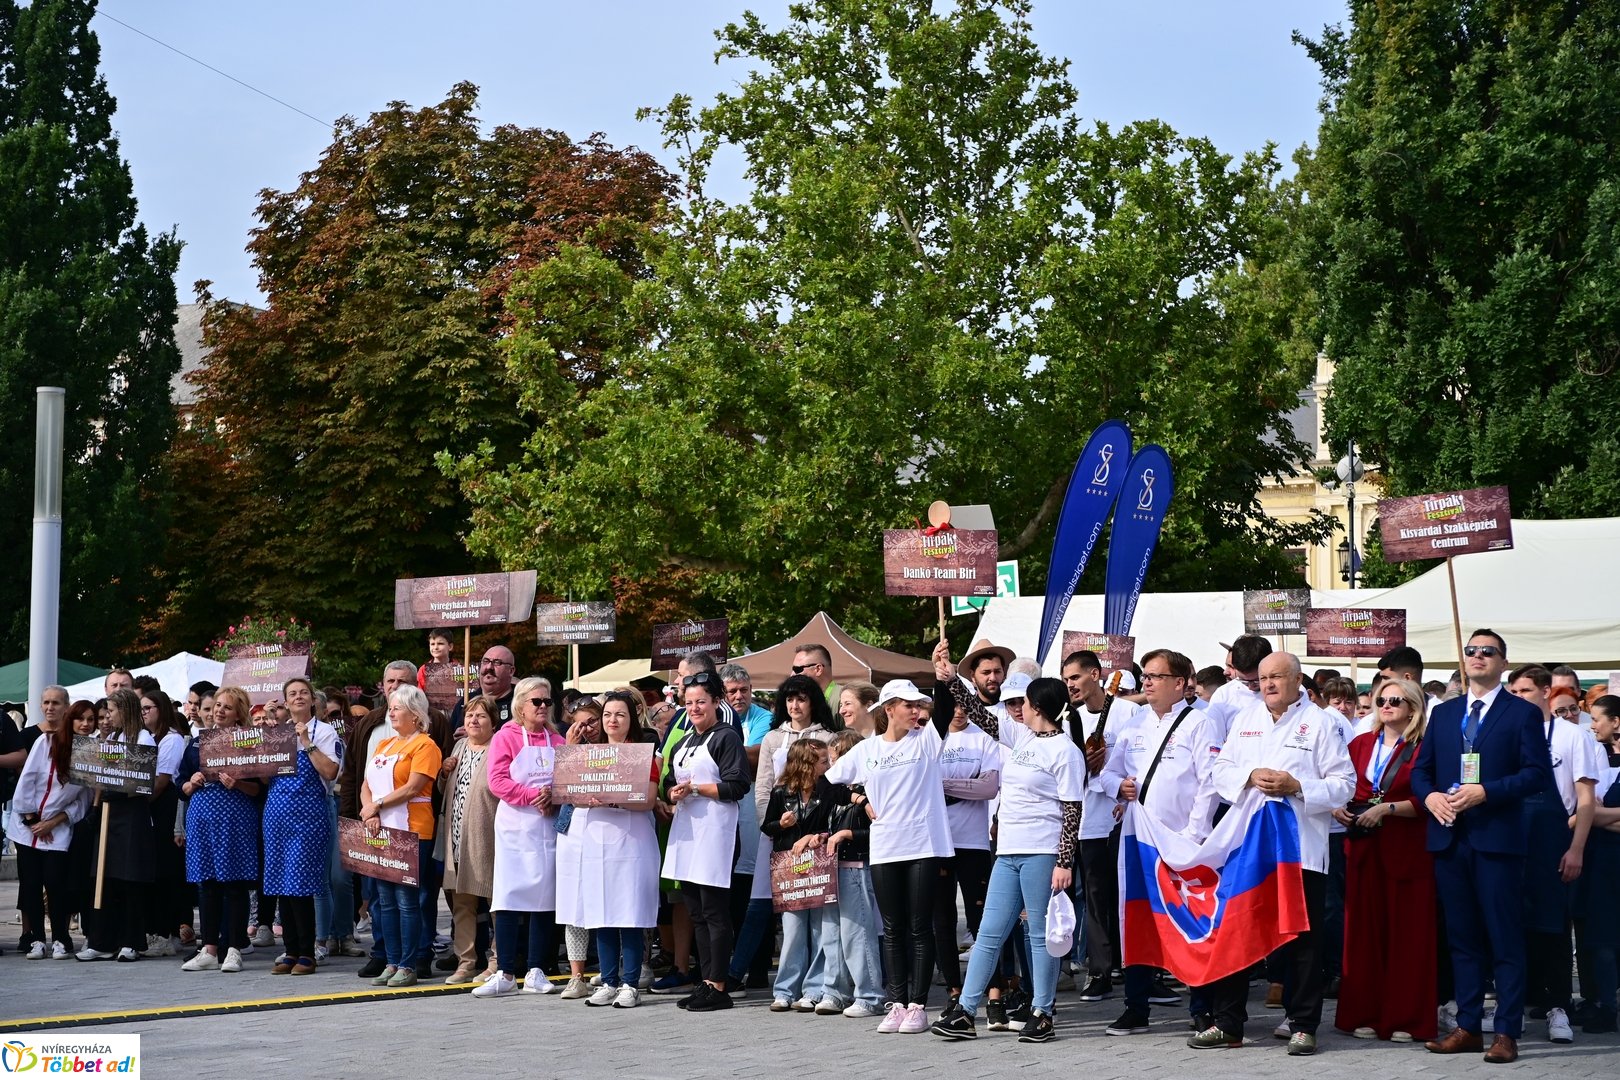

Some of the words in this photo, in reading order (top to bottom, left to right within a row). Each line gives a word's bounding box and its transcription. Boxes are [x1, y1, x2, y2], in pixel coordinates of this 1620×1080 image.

[1423, 494, 1460, 512] Tirpák
[1426, 506, 1463, 520] Fesztivál
[1400, 524, 1442, 539] Kisvárdai
[1443, 518, 1498, 534] Szakképzési
[921, 532, 954, 548] Tirpák
[1431, 535, 1469, 549] Centrum
[923, 545, 955, 557] Fesztivál
[903, 566, 931, 579] Dankó
[933, 567, 957, 579] Team
[959, 567, 976, 579] Biri
[430, 600, 467, 611] Nyíregyháza
[441, 609, 480, 620] Polgárőrség
[1329, 636, 1385, 645] Hungast-Elamen
[233, 727, 260, 742] Tirpák
[234, 738, 262, 748] Fesztivál
[206, 757, 226, 767] Sóstói
[226, 754, 257, 766] Polgárőr
[258, 752, 290, 764] Egyesület
[588, 747, 616, 760] Tirpák
[567, 783, 600, 793] Nyíregyháza
[602, 782, 632, 792] Városháza
[348, 849, 379, 864] Generációk
[379, 856, 410, 871] Egyesülete
